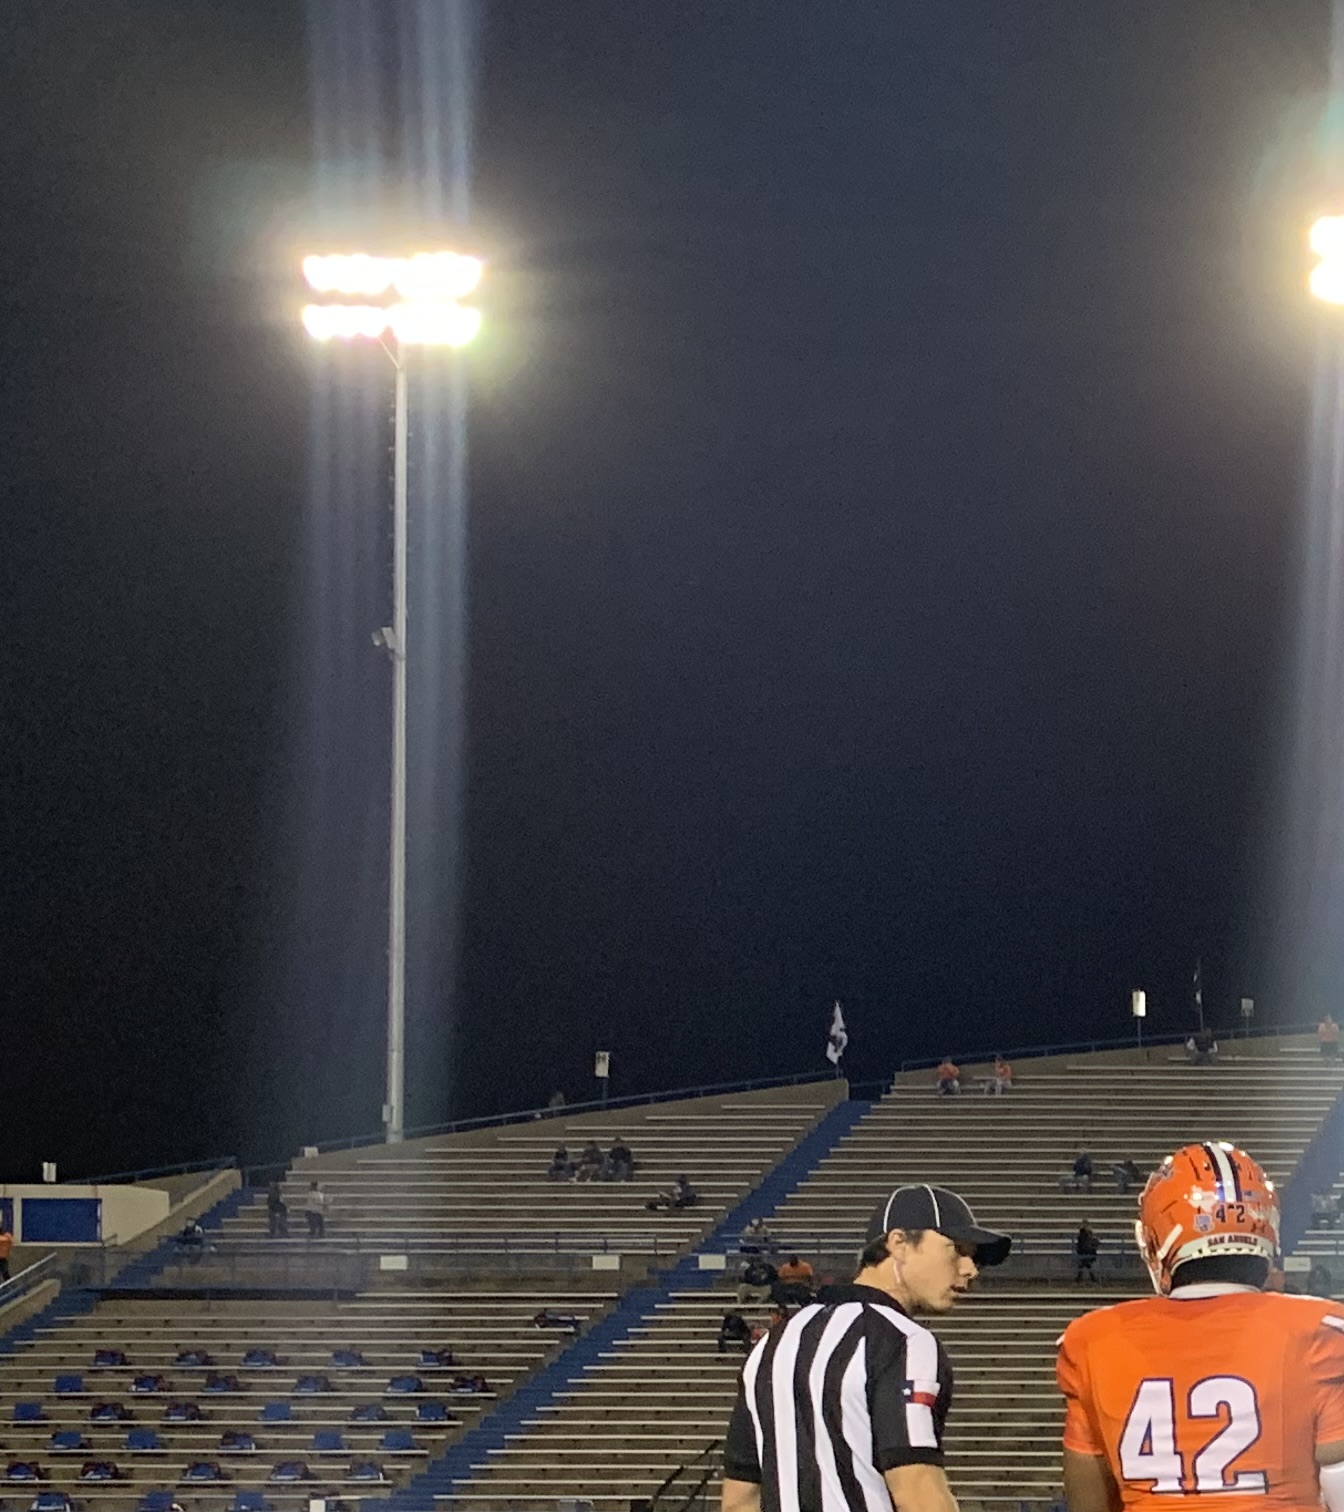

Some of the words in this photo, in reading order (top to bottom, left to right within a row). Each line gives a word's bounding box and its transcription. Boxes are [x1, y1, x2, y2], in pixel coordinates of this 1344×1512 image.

[1216, 1204, 1245, 1223] 42
[1208, 1236, 1225, 1247] SAN
[1228, 1235, 1257, 1246] ANGELO
[1118, 1374, 1269, 1496] 42
